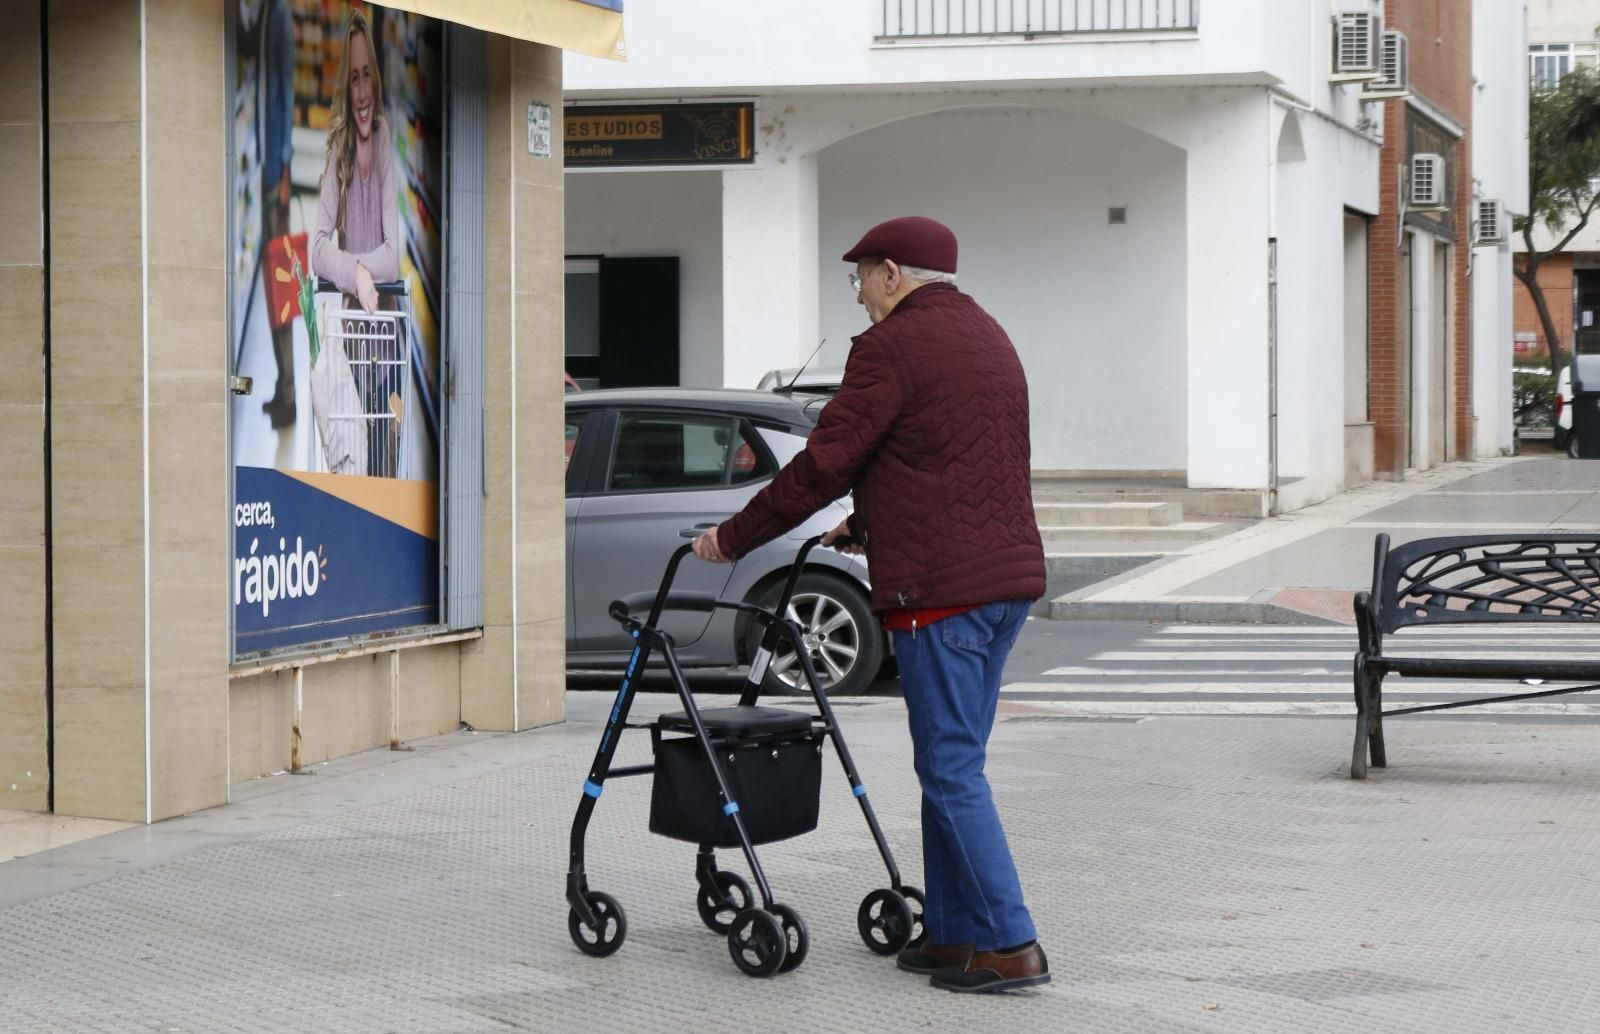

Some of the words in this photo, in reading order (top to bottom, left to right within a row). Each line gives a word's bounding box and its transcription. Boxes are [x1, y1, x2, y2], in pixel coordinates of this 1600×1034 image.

[567, 120, 661, 137] ESTUDIOS
[235, 501, 275, 529] cerca,
[235, 535, 320, 618] rápido
